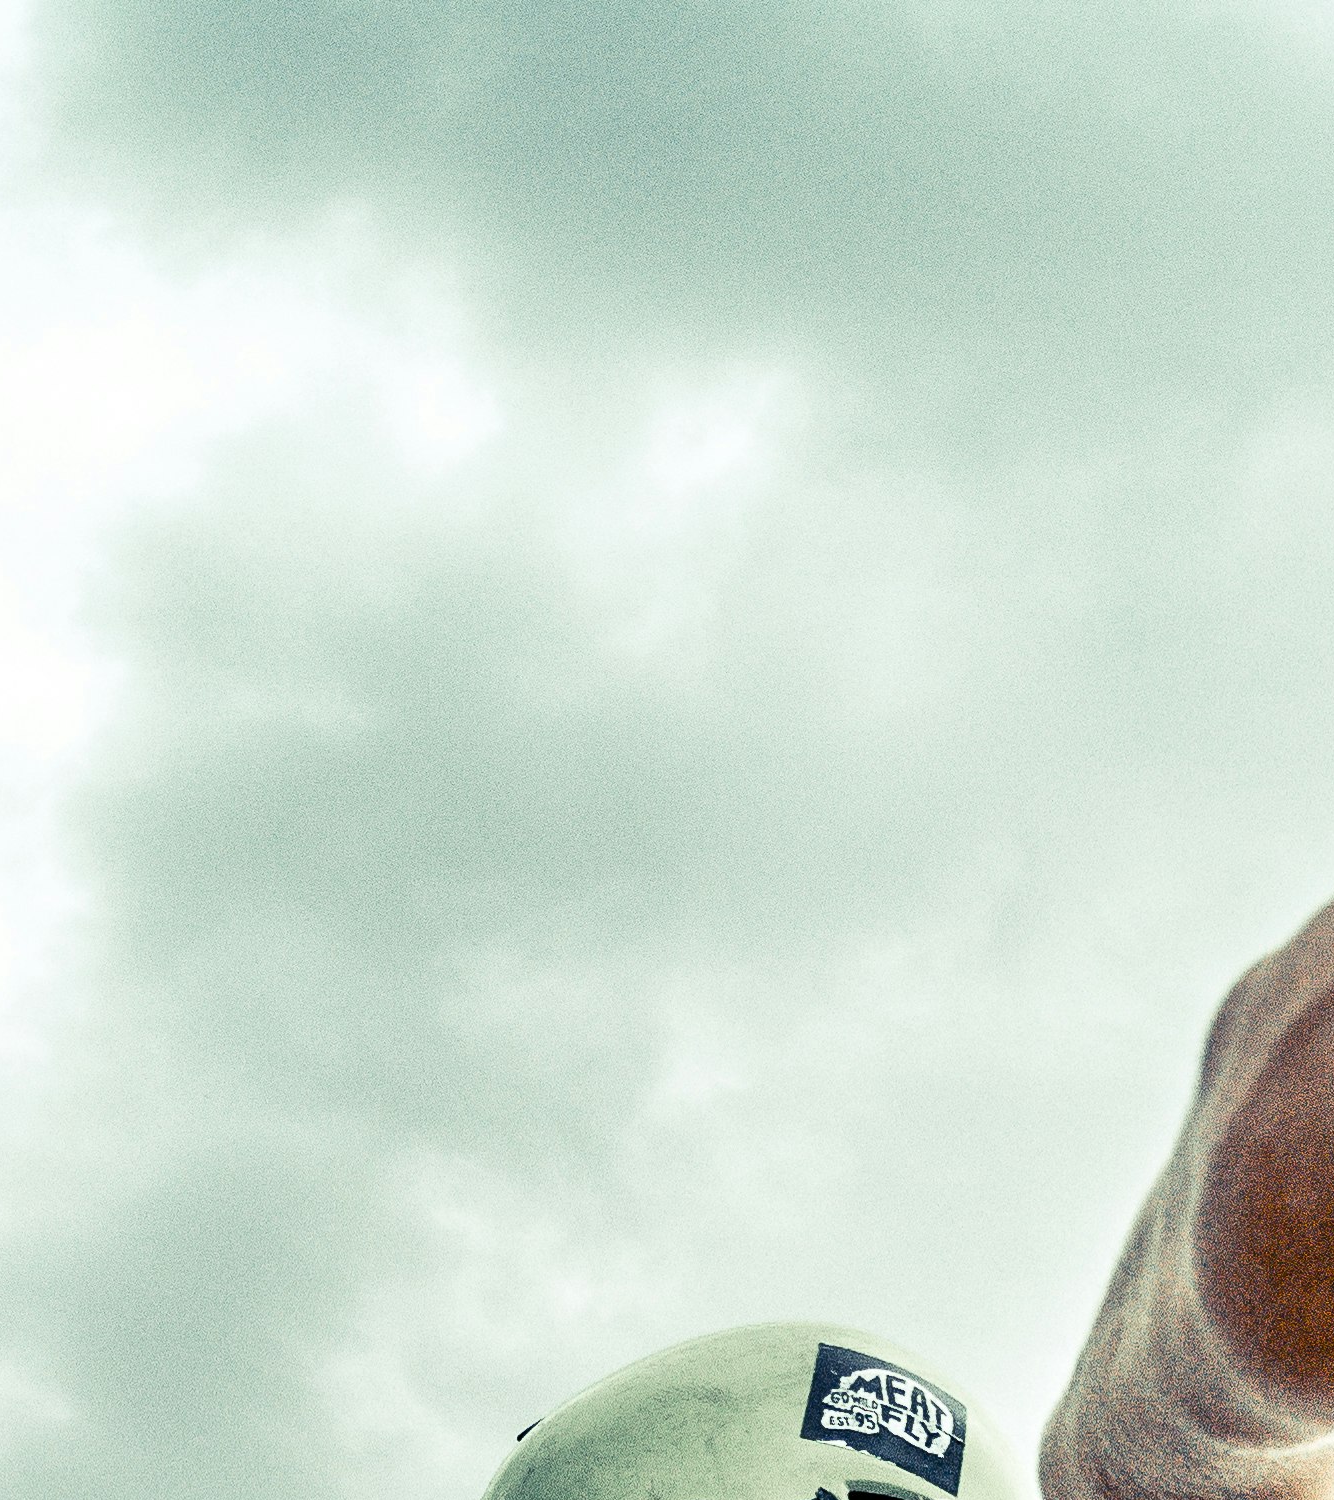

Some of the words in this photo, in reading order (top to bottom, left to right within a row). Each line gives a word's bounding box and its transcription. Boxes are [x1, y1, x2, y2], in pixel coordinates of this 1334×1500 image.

[829, 1415, 850, 1427] EST
[854, 1412, 876, 1430] 95
[848, 1374, 947, 1430] MEAT
[880, 1403, 940, 1449] FLY
